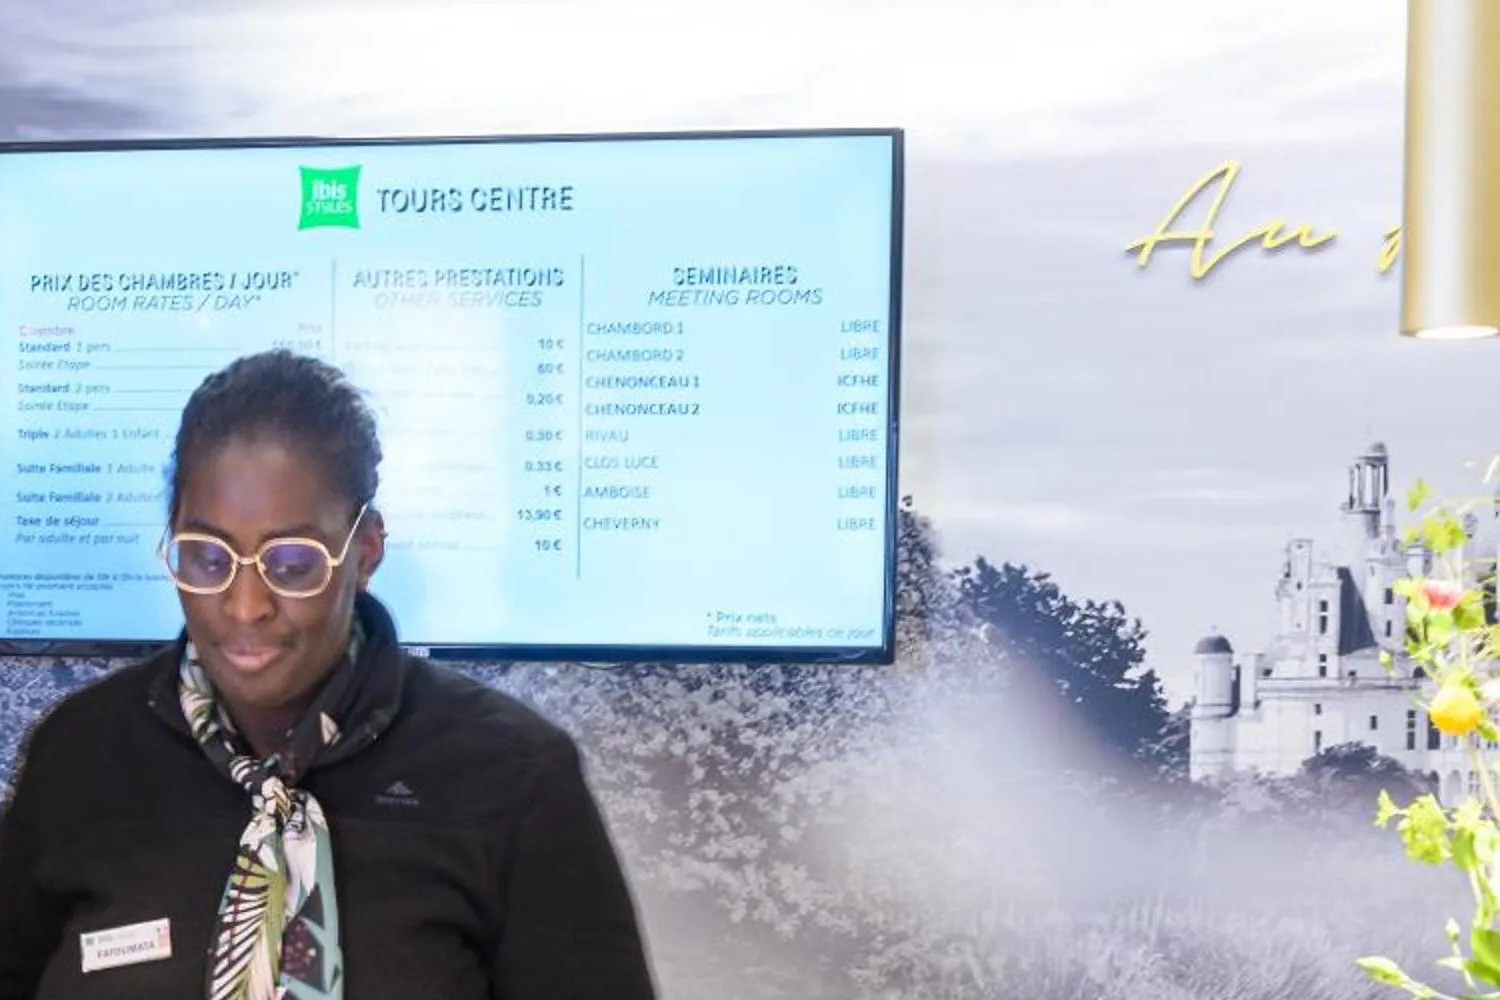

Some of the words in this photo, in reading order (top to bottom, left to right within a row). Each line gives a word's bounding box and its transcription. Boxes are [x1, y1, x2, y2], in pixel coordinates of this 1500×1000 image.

[311, 179, 349, 201] ibis
[377, 187, 463, 213] TOURS
[470, 186, 575, 212] CENTRE
[306, 200, 354, 216] STYLES
[1123, 158, 1341, 279] Au
[353, 269, 428, 288] AUTRES
[435, 268, 564, 287] PRESTATIONS
[673, 266, 797, 285] SEMINAIRES
[31, 273, 72, 293] PRIX
[78, 273, 113, 292] DES
[118, 272, 223, 292] CHAMBRES
[67, 295, 127, 313] ROOM
[132, 294, 193, 312] RATES
[375, 292, 443, 309] OTHER
[450, 291, 544, 308] SERVICES
[647, 289, 739, 307] MEETING
[745, 288, 823, 305] ROOMS
[587, 322, 673, 335] CHAMBORD
[677, 322, 684, 335] 1
[841, 319, 880, 333] LIBRE
[19, 341, 71, 352] Standard
[537, 338, 553, 349] 10
[586, 349, 673, 362] CHAMBORD
[676, 349, 684, 362] 2
[840, 347, 879, 361] LIBRE
[537, 362, 553, 374] 60
[17, 383, 70, 394] Standard
[585, 376, 689, 389] CHENONCEAU
[692, 376, 700, 388] 1
[585, 403, 689, 416] CHENONCEAU
[691, 403, 700, 416] 2
[17, 428, 49, 441] Triple
[585, 430, 629, 442] RIVAU
[838, 429, 878, 442] LIBRE
[16, 463, 46, 474] Suite
[50, 463, 100, 474] Familiale
[584, 456, 619, 469] CLOS
[625, 456, 659, 469] LUCE
[838, 456, 877, 469] LIBRE
[16, 492, 45, 503] Suite
[50, 491, 100, 503] Familiale
[583, 486, 651, 499] AMBOISE
[837, 486, 876, 499] LIBRE
[16, 515, 41, 526] Taxe
[45, 515, 60, 526] de
[64, 515, 99, 529] séjour
[583, 517, 661, 530] CHEVERNY
[837, 518, 876, 531] LIBRE
[15, 534, 35, 545] Par
[38, 533, 75, 544] adulte
[79, 534, 90, 544] et
[93, 535, 114, 546] par
[117, 533, 140, 545] nuit
[534, 539, 551, 551] 10
[716, 610, 742, 623] Prix
